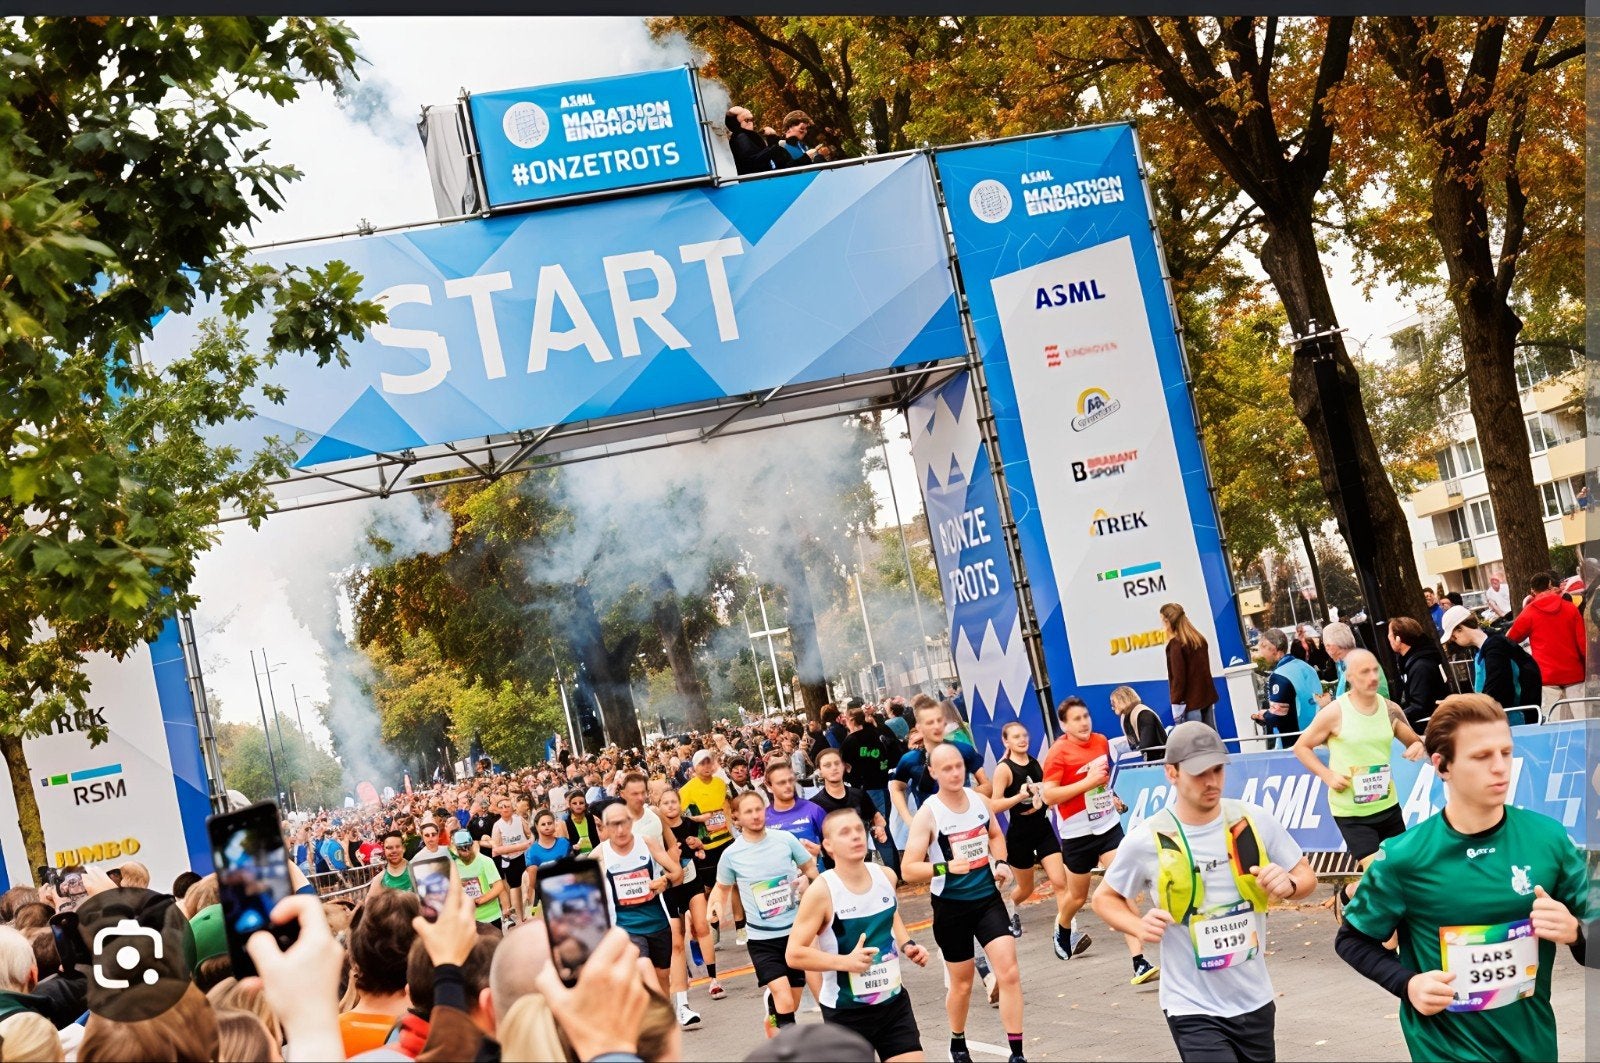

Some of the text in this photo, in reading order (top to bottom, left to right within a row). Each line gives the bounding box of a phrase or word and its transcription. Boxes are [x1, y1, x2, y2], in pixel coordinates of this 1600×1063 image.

[560, 100, 671, 129] MARATHON
[565, 114, 674, 142] EINDHOVEN
[511, 141, 680, 187] #ONZETROTS
[1021, 170, 1054, 185] ASML
[1023, 175, 1122, 203] MARATHON
[1026, 188, 1125, 217] EINDHOVEN
[1036, 279, 1106, 309] ASML
[370, 236, 745, 395] START
[1090, 464, 1125, 479] SPORT
[1093, 511, 1148, 536] TREK
[948, 558, 1000, 606] TROTS
[1123, 575, 1167, 599] RSM
[73, 779, 127, 806] RSM
[55, 838, 141, 869] JUMBO
[1471, 949, 1513, 964] LARS
[1470, 965, 1517, 984] 3953
